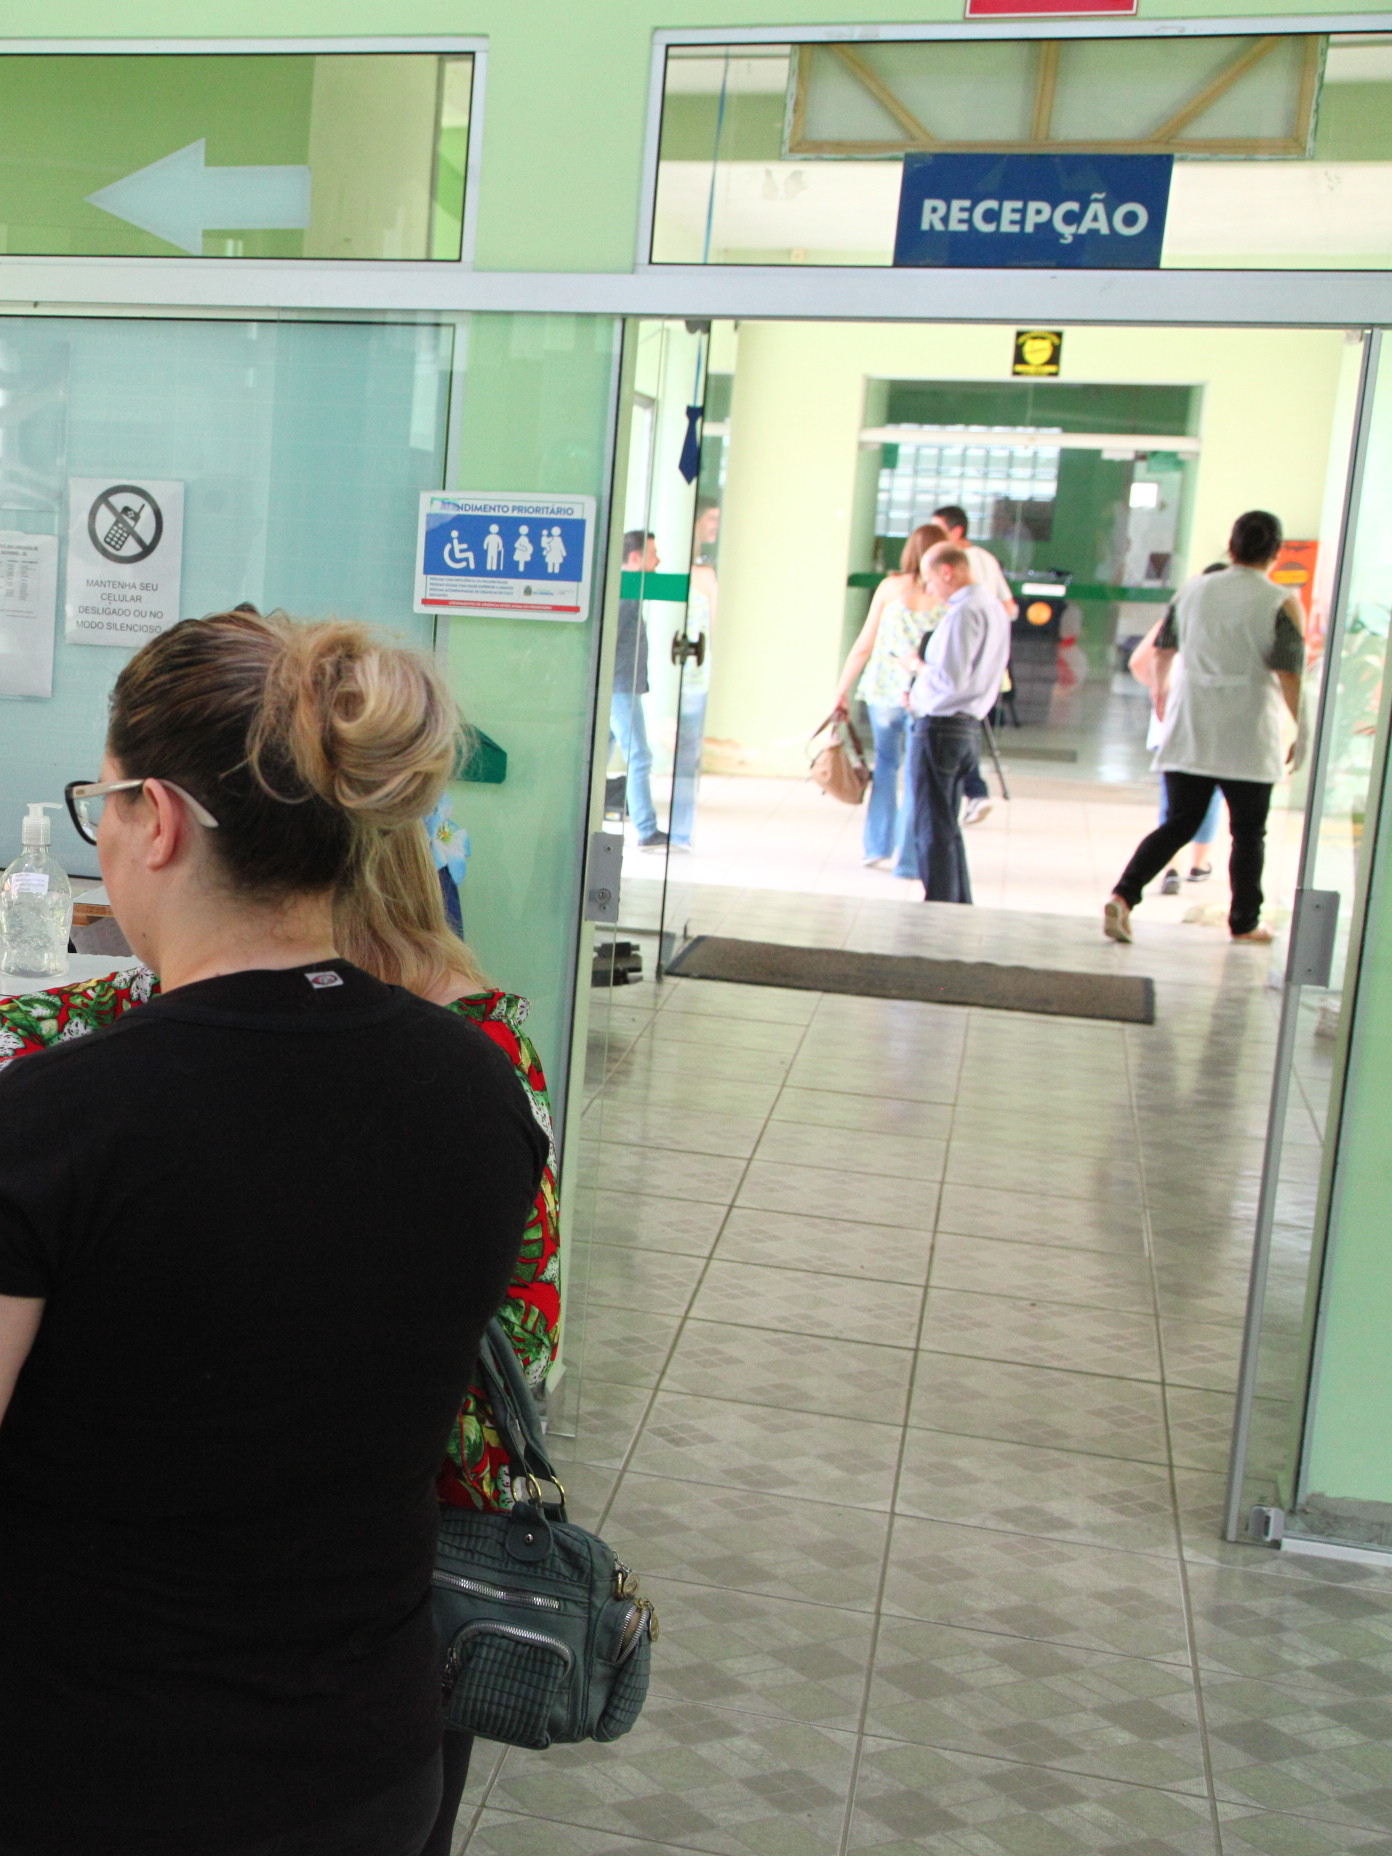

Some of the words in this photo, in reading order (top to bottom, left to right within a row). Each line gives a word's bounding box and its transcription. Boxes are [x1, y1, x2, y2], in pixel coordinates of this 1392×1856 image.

[920, 192, 1149, 244] RECEPÇÃO
[511, 504, 574, 516] PRIORITÁRIO
[86, 579, 137, 590] MANTENHA
[139, 582, 159, 592] SEU
[100, 593, 143, 603] CELULAR
[78, 605, 131, 617] DESLIGADO
[133, 609, 147, 618] OU
[149, 610, 164, 619] NO
[76, 620, 104, 629] MODO
[106, 622, 162, 634] SILENCIOSO
